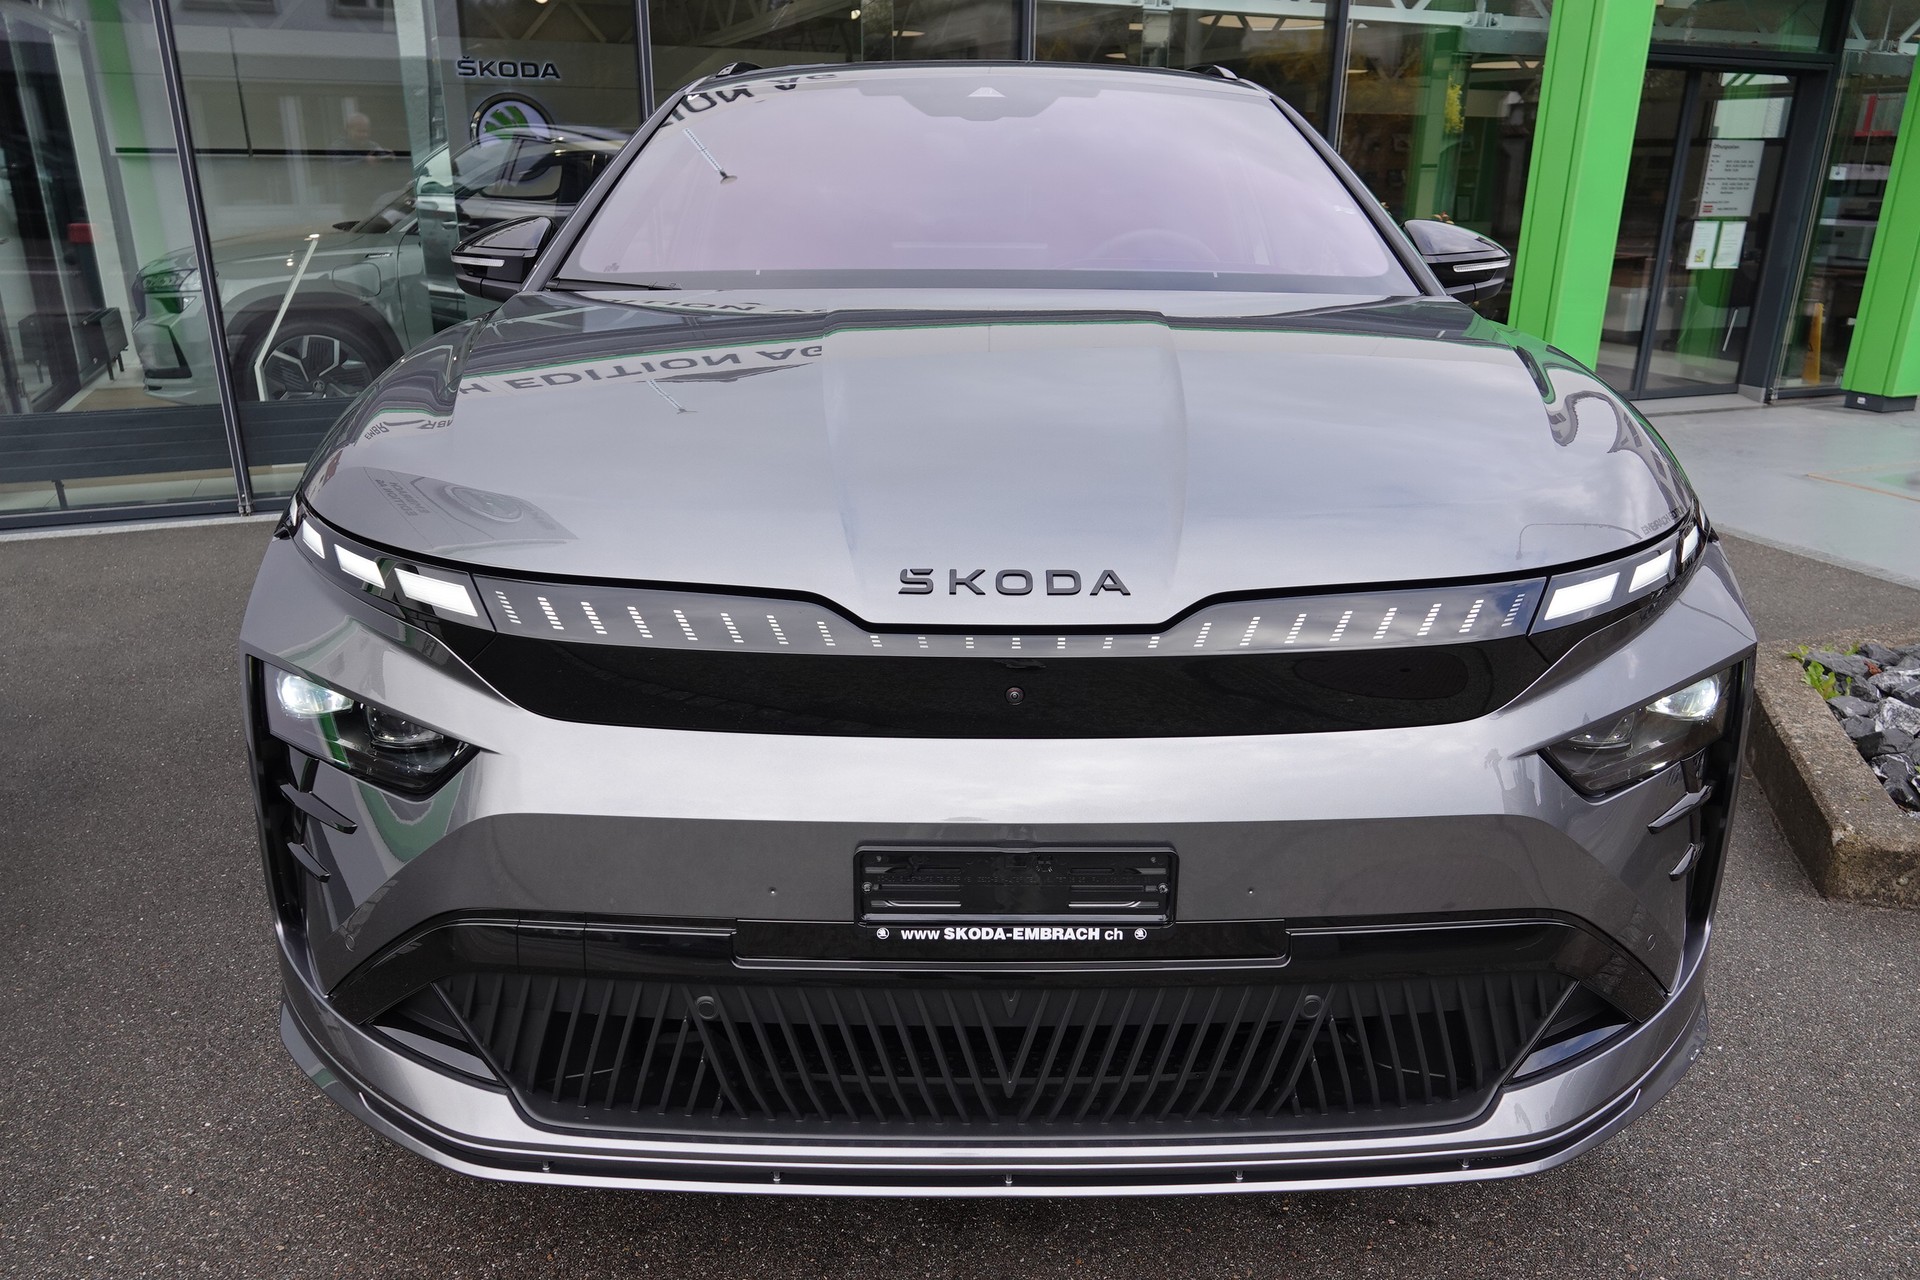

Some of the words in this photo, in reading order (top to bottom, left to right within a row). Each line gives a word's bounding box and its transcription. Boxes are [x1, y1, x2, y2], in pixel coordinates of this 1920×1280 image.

[456, 55, 561, 79] ŠKODA
[901, 929, 940, 940] www
[943, 927, 1100, 941] SKODA-EMBRACH
[1104, 928, 1123, 940] ch
